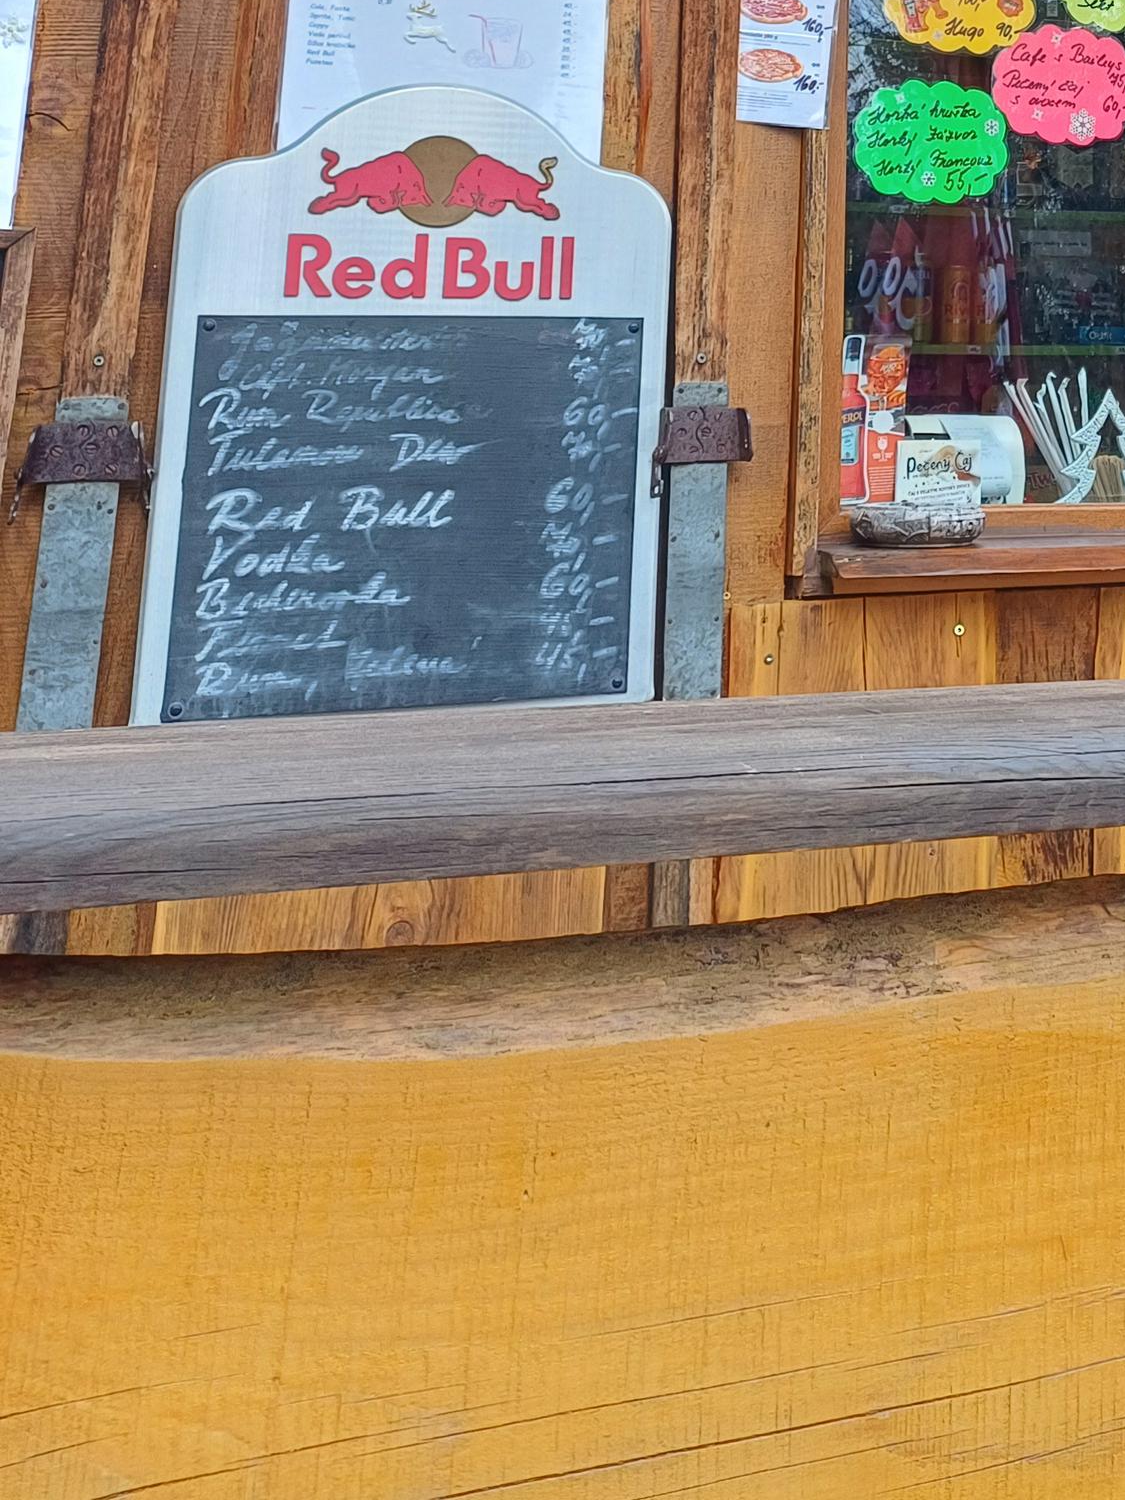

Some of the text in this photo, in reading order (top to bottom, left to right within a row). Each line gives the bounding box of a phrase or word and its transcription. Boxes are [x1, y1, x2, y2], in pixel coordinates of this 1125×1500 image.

[944, 16, 1024, 42] Hugo 90,-
[1054, 53, 1064, 62] s
[1068, 42, 1123, 75] Baileys
[1010, 95, 1021, 105] s
[283, 233, 576, 301] Red Bull
[206, 487, 317, 535] Red
[338, 485, 456, 533] Bull
[202, 532, 346, 581] Vodka
